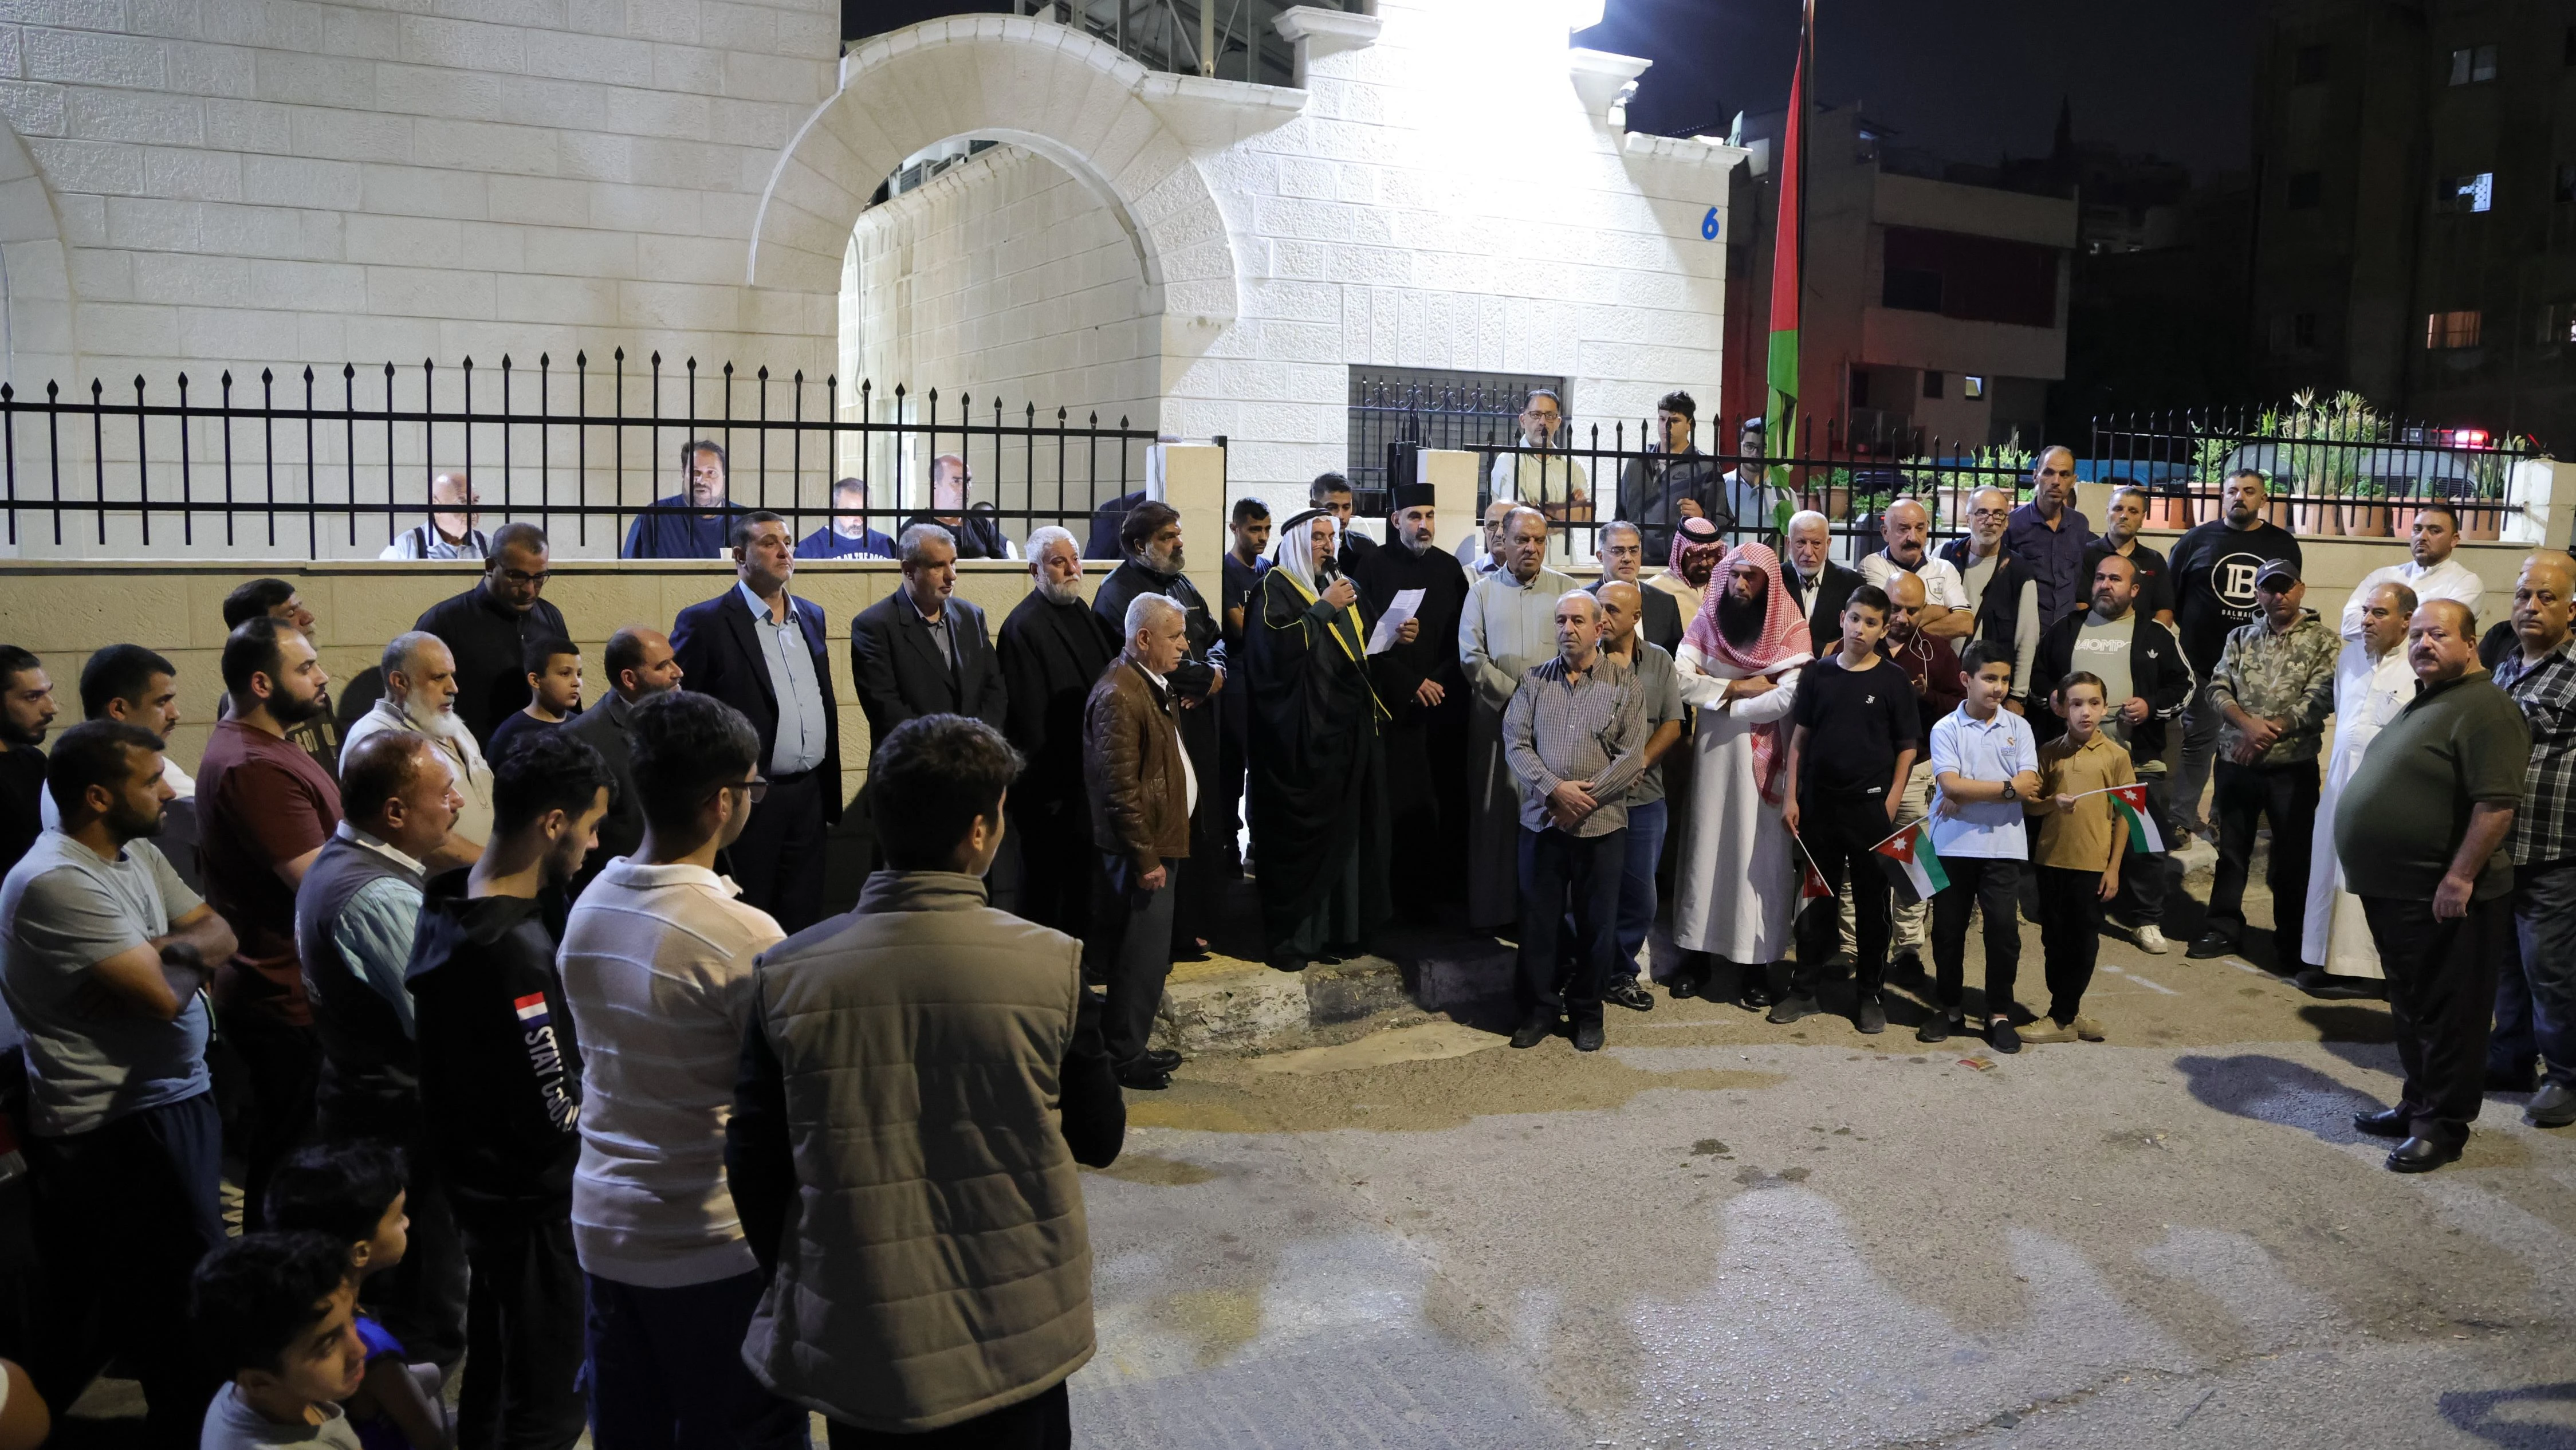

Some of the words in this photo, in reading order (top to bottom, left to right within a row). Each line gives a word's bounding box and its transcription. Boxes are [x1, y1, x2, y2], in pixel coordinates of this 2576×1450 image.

[1701, 207, 1719, 240] 6
[2221, 609, 2251, 618] BALMAI
[525, 1025, 563, 1077] STAY
